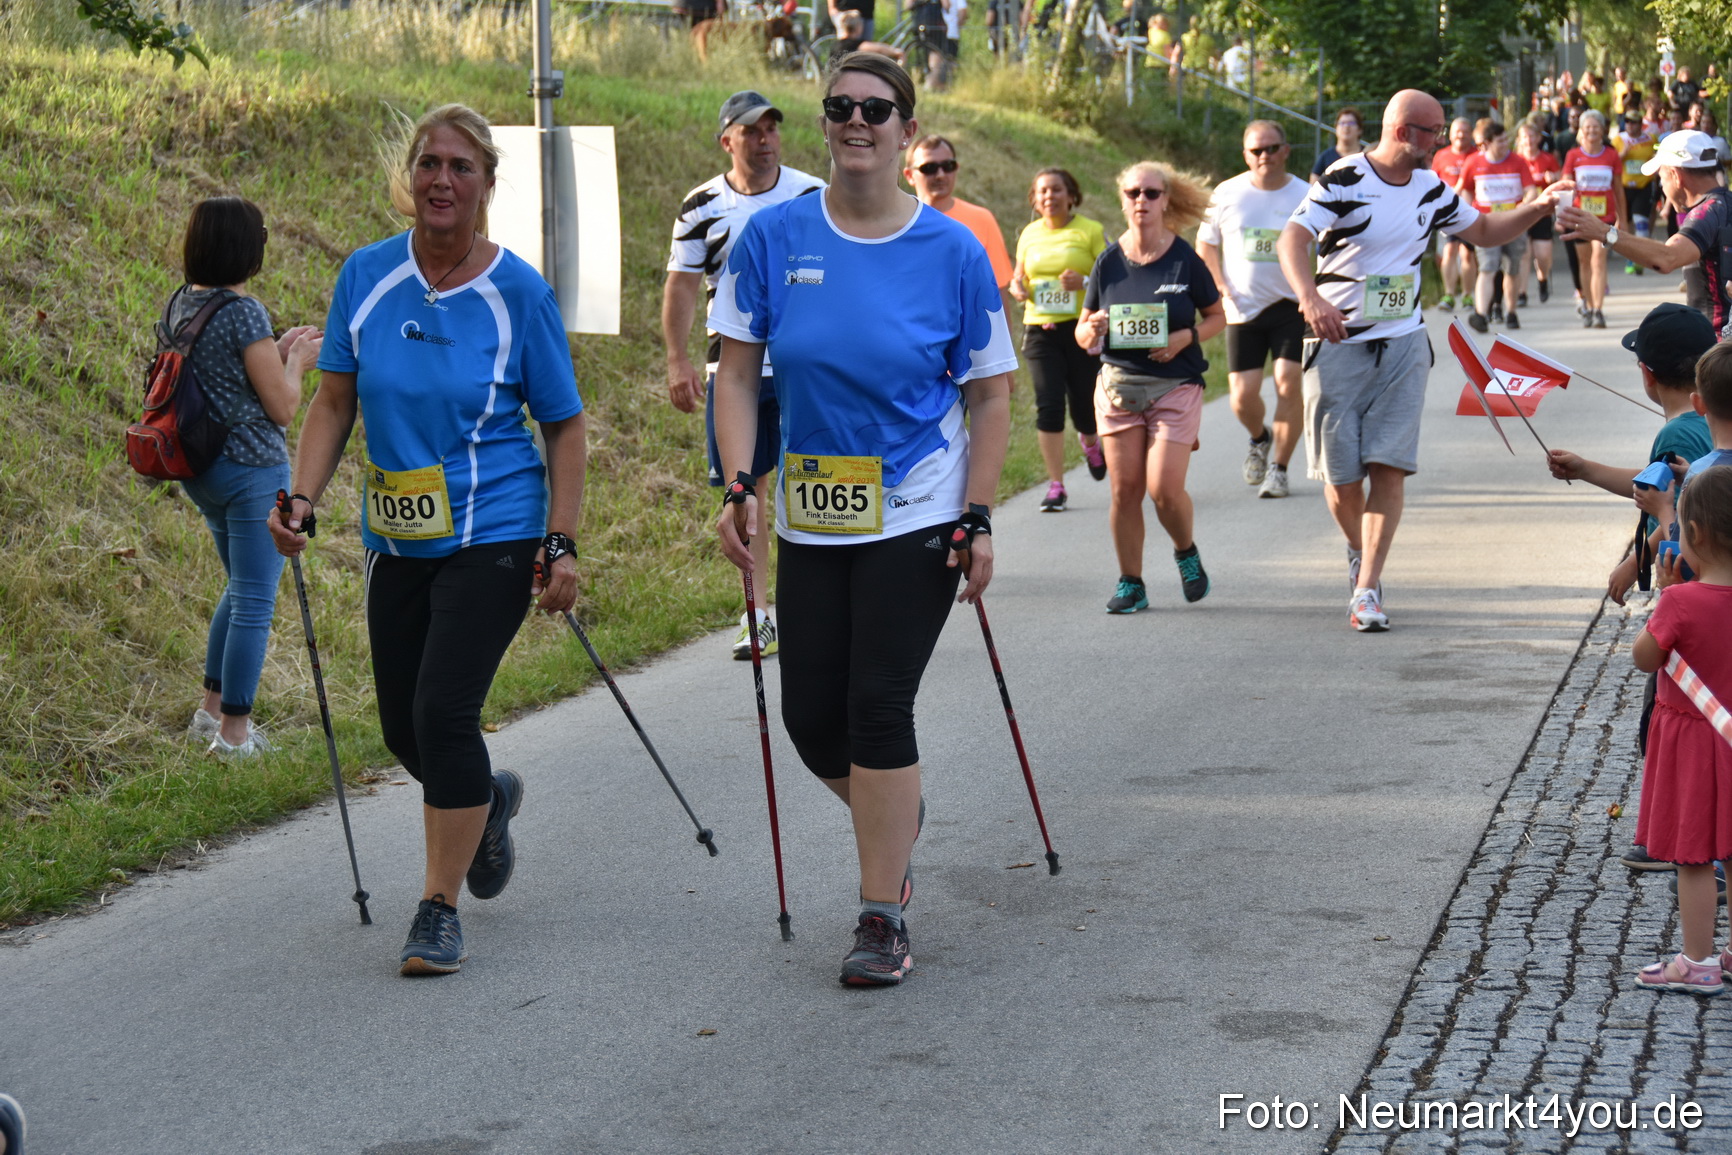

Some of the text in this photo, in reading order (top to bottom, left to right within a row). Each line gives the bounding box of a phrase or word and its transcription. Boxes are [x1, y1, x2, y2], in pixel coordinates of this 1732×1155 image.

[1038, 291, 1071, 304] 1288
[1378, 290, 1406, 307] 798
[1117, 319, 1160, 336] 1388
[425, 334, 456, 347] classic
[373, 491, 435, 520] 1080
[796, 483, 868, 512] 1065
[909, 494, 934, 504] classic
[383, 519, 403, 528] Mailer
[806, 511, 858, 521] Fink Elisabeth
[549, 535, 559, 555] LEKI
[745, 571, 754, 601] ADVENTUR
